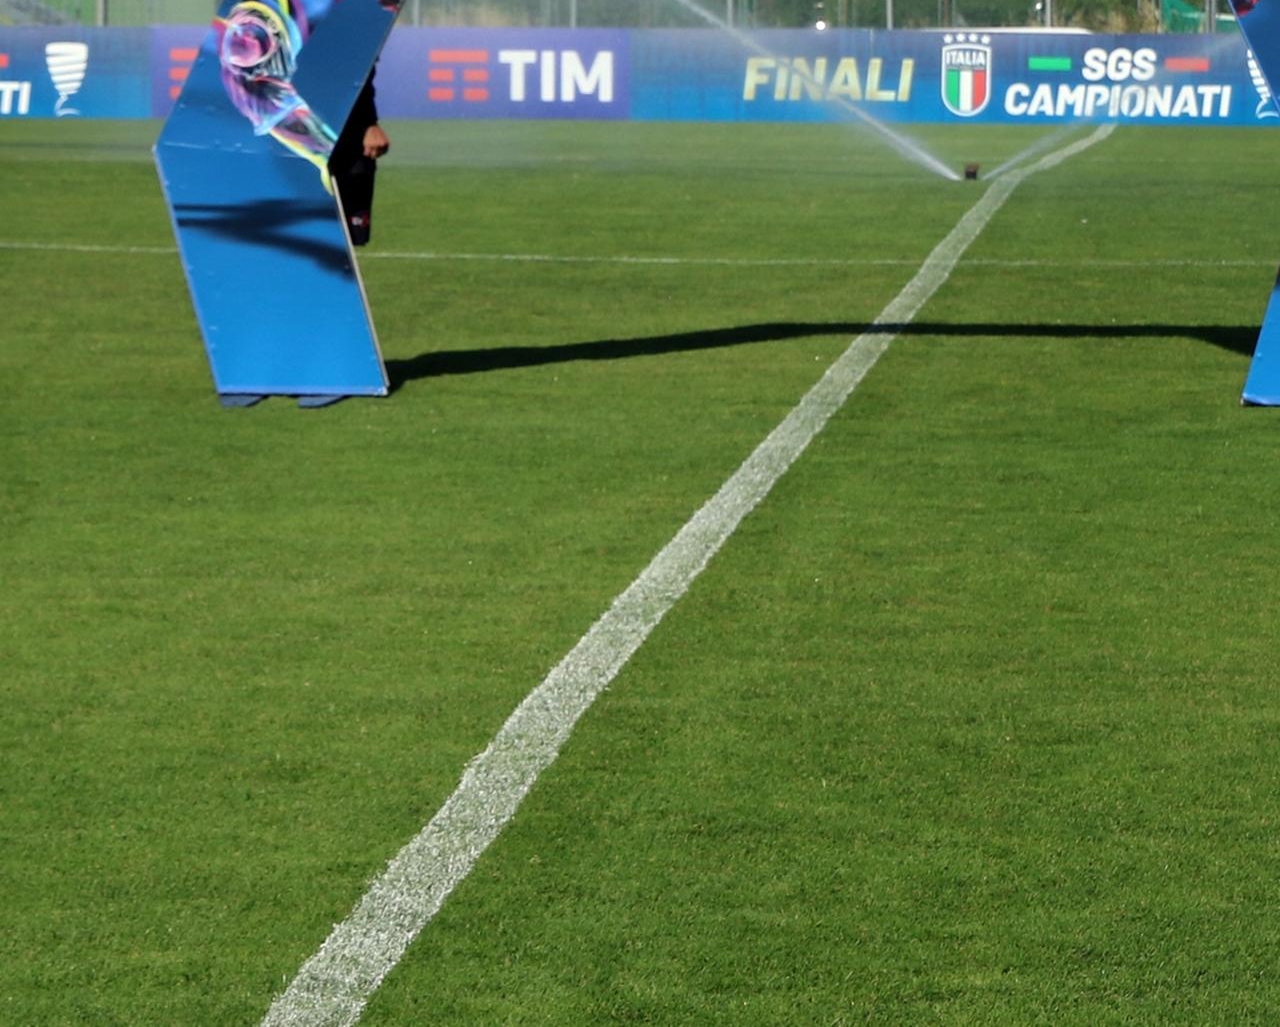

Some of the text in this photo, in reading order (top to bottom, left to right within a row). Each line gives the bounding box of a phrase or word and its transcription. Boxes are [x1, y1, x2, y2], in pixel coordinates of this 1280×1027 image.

[946, 51, 985, 65] ITALIA
[1082, 48, 1157, 81] SGS
[499, 49, 614, 102] TIM
[743, 57, 915, 102] FINALI
[1004, 83, 1232, 117] CAMPIONATI
